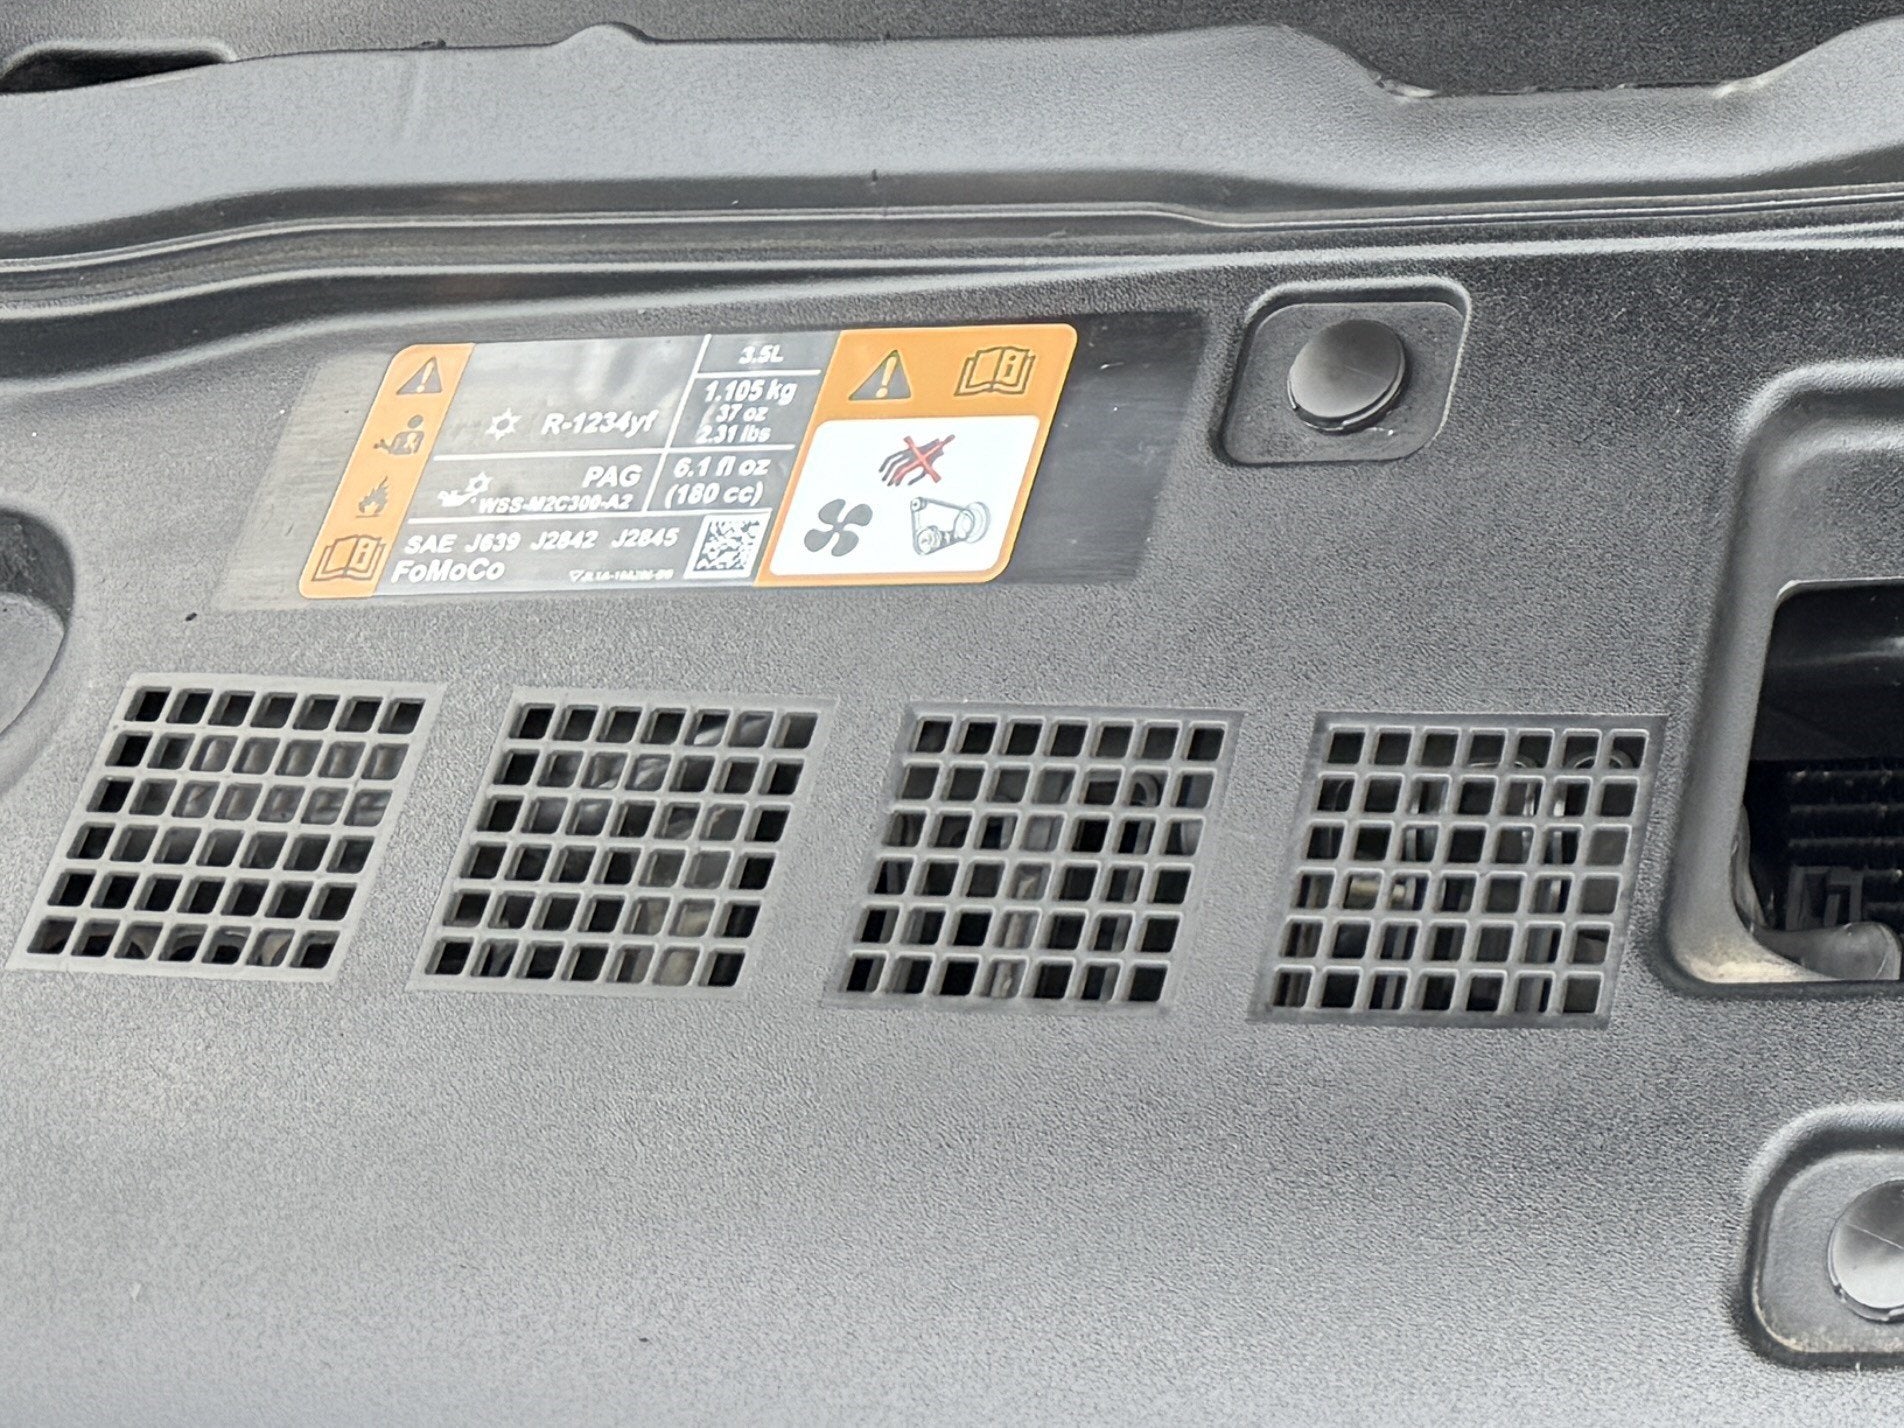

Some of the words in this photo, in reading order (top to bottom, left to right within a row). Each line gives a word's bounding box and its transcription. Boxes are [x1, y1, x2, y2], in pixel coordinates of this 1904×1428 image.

[738, 344, 784, 365] 3.5L
[705, 379, 766, 403] 1.105
[766, 378, 798, 406] kg
[540, 409, 660, 438] R-1234yf
[715, 403, 743, 422] 37
[743, 406, 769, 422] oz
[695, 424, 739, 445] 2.31
[739, 424, 772, 443] lbs
[581, 463, 644, 489] PAG
[672, 455, 712, 479] 6.1
[715, 455, 737, 477] fl
[738, 458, 772, 477] oz
[664, 482, 720, 510] (180
[722, 480, 764, 507] cc)
[403, 534, 457, 555] SAE
[464, 531, 522, 554] J639
[529, 529, 600, 551] J2842
[611, 526, 681, 549] J2845
[390, 556, 506, 584] FoMoCo
